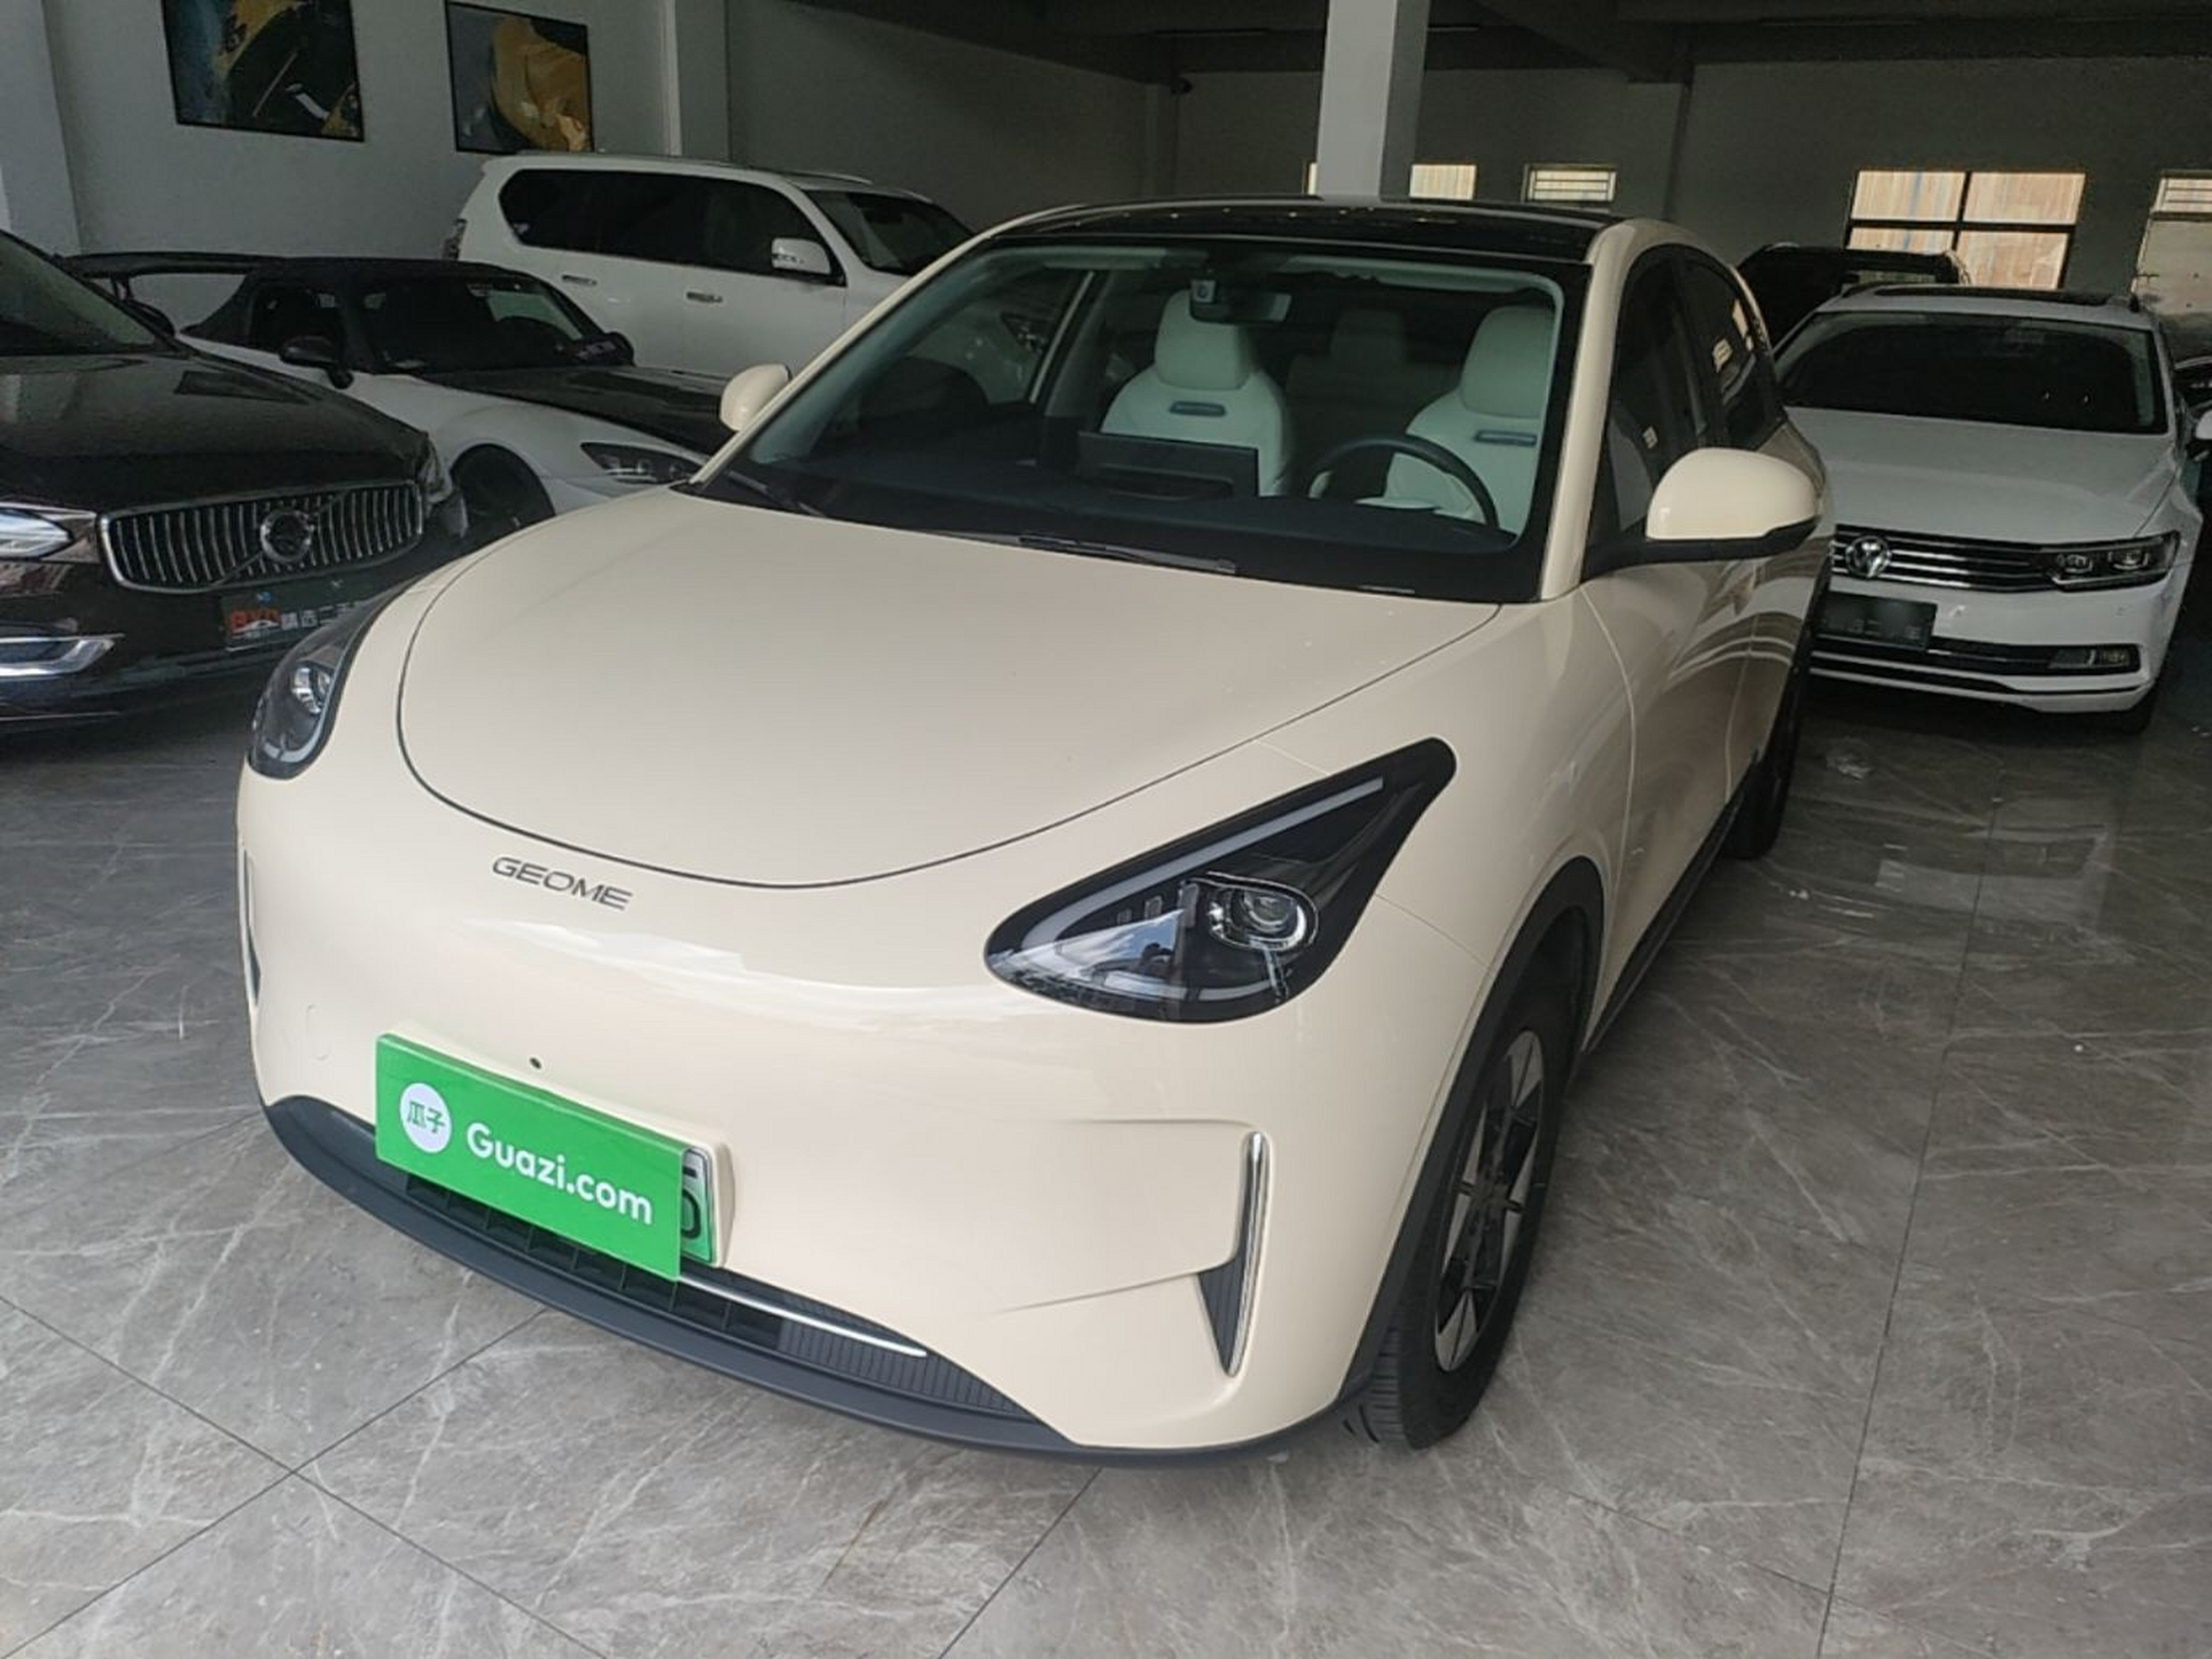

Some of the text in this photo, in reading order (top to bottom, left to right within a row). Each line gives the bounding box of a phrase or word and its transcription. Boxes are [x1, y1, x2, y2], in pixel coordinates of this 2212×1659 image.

[493, 857, 633, 910] GEOME
[407, 1100, 446, 1134] 瓜子
[467, 1122, 652, 1225] Guazi.com
